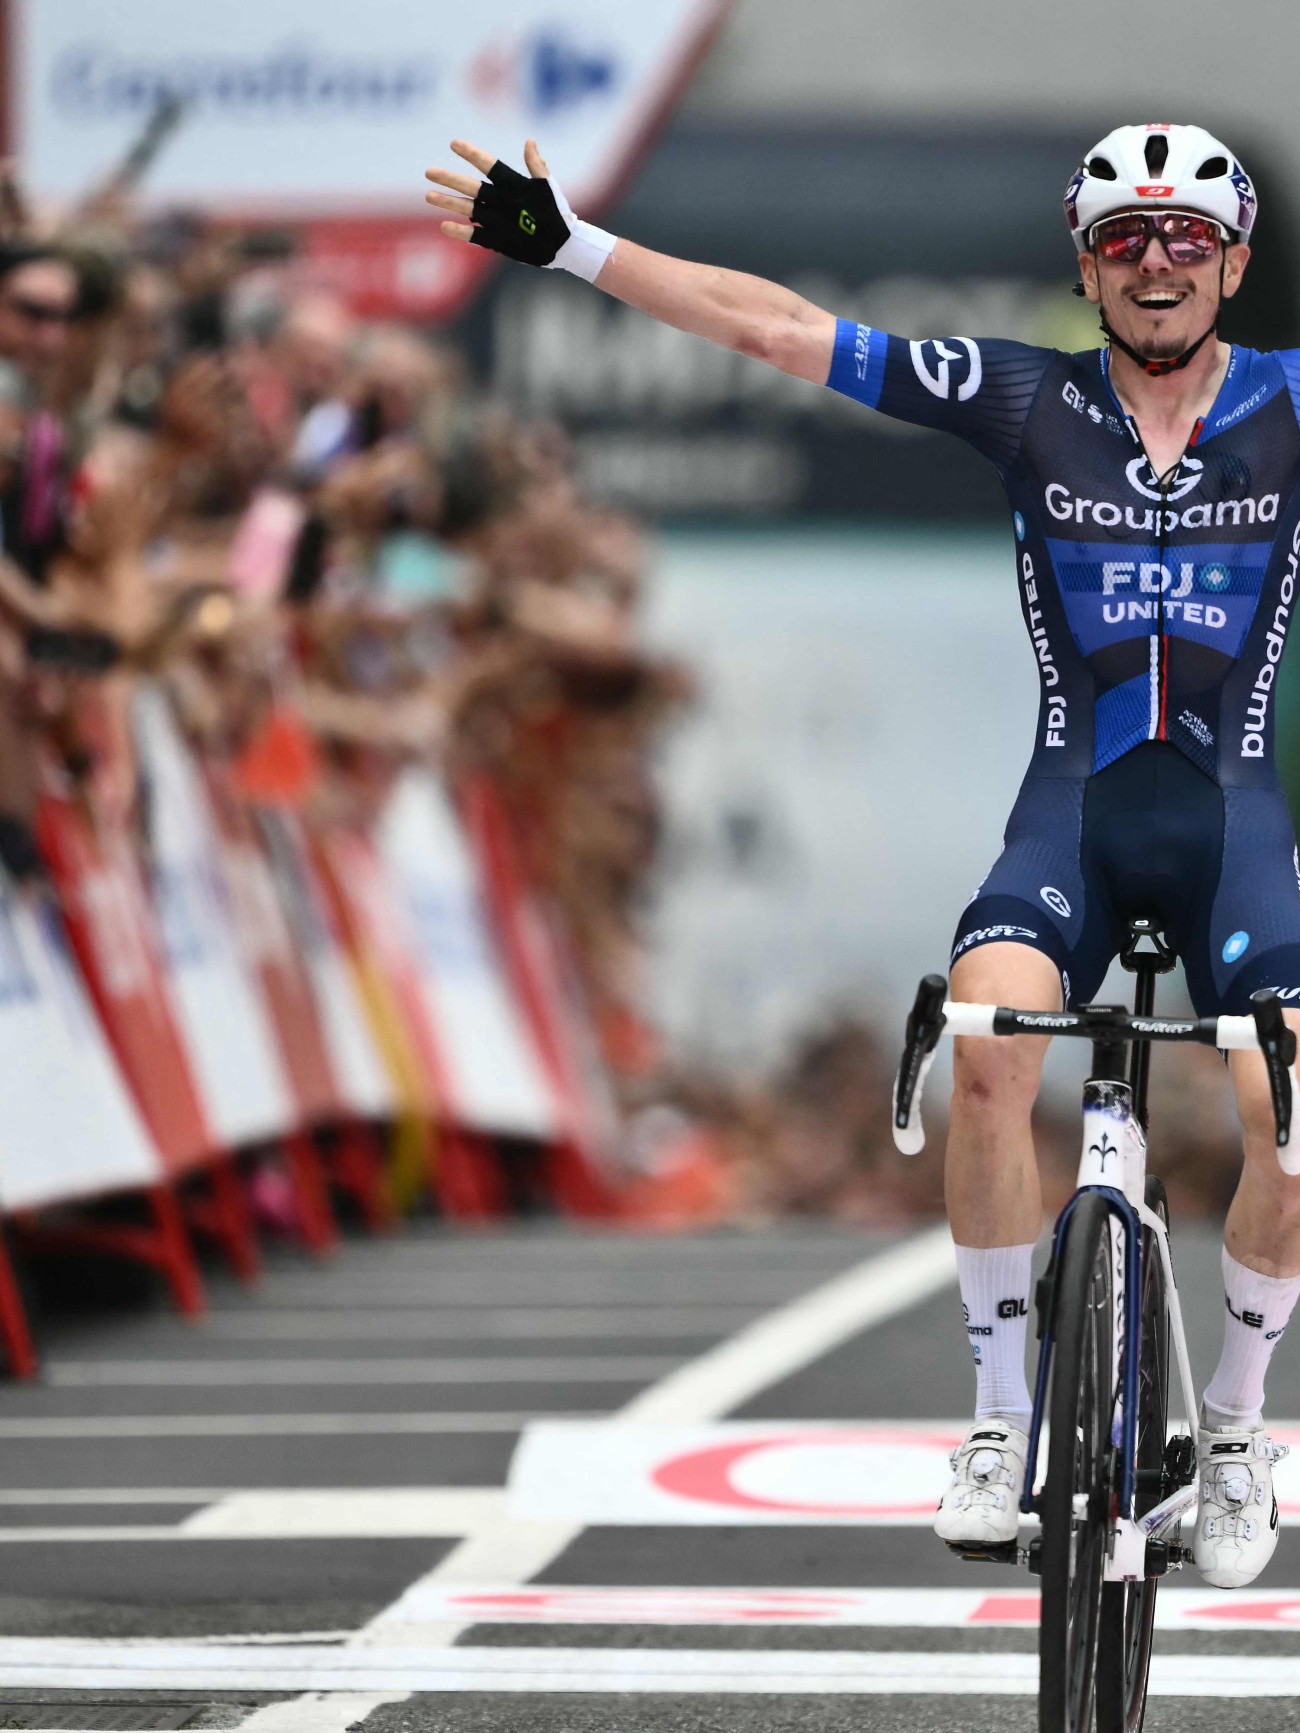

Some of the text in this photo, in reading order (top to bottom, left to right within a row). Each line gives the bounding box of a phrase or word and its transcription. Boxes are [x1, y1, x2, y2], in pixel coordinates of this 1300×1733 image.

[1044, 483, 1280, 537] Groupama
[1102, 562, 1194, 598] FDJ
[1102, 601, 1227, 629] UNITED
[1022, 552, 1067, 747] FDJ UNITED
